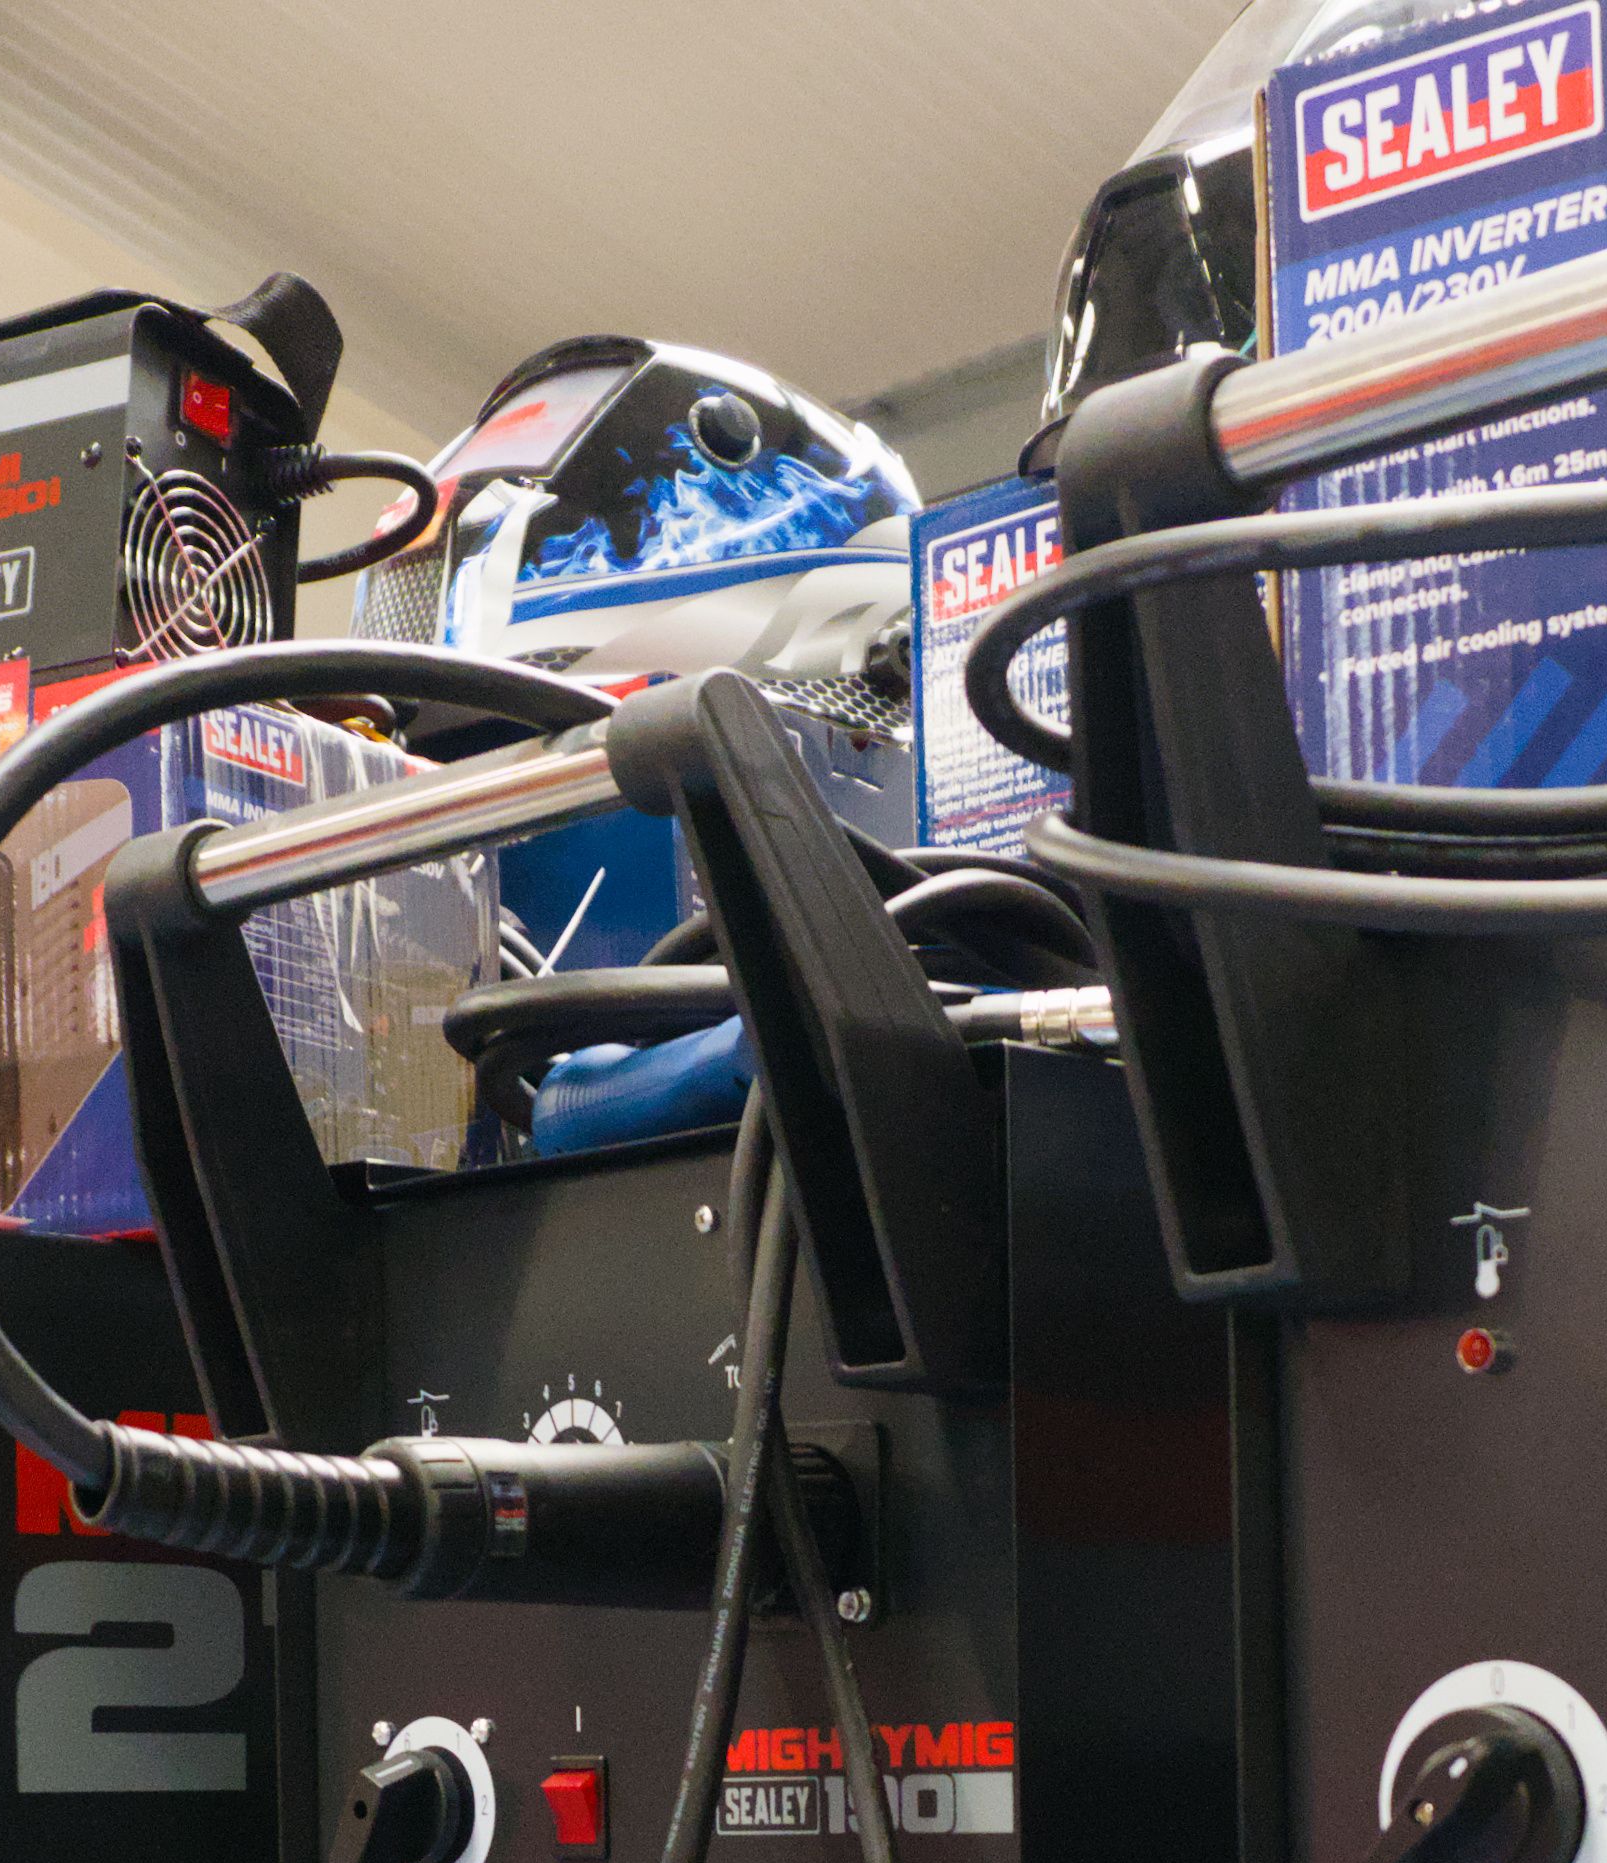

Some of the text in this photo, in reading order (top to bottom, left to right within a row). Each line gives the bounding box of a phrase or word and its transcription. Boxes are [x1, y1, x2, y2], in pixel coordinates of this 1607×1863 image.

[1322, 31, 1570, 191] SEALEY
[1305, 247, 1398, 306] MMA
[1411, 190, 1607, 272] INVERTER
[1306, 256, 1526, 349] 200A/230V
[943, 517, 1058, 609] SEALE
[1338, 558, 1405, 595] clamp
[1339, 581, 1469, 627] connectors.
[1341, 645, 1416, 680] Forced
[1421, 635, 1452, 662] air
[1457, 615, 1543, 655] cooling
[210, 709, 294, 772] SEALEY
[206, 789, 241, 815] MMA
[567, 1373, 576, 1391] 5
[594, 1379, 602, 1397] 6
[615, 1400, 622, 1417] 7
[14, 1560, 248, 1793] 2
[726, 1721, 1014, 1772] MIGHYMIG
[480, 1794, 489, 1816] 2
[725, 1786, 809, 1826] SEALEY
